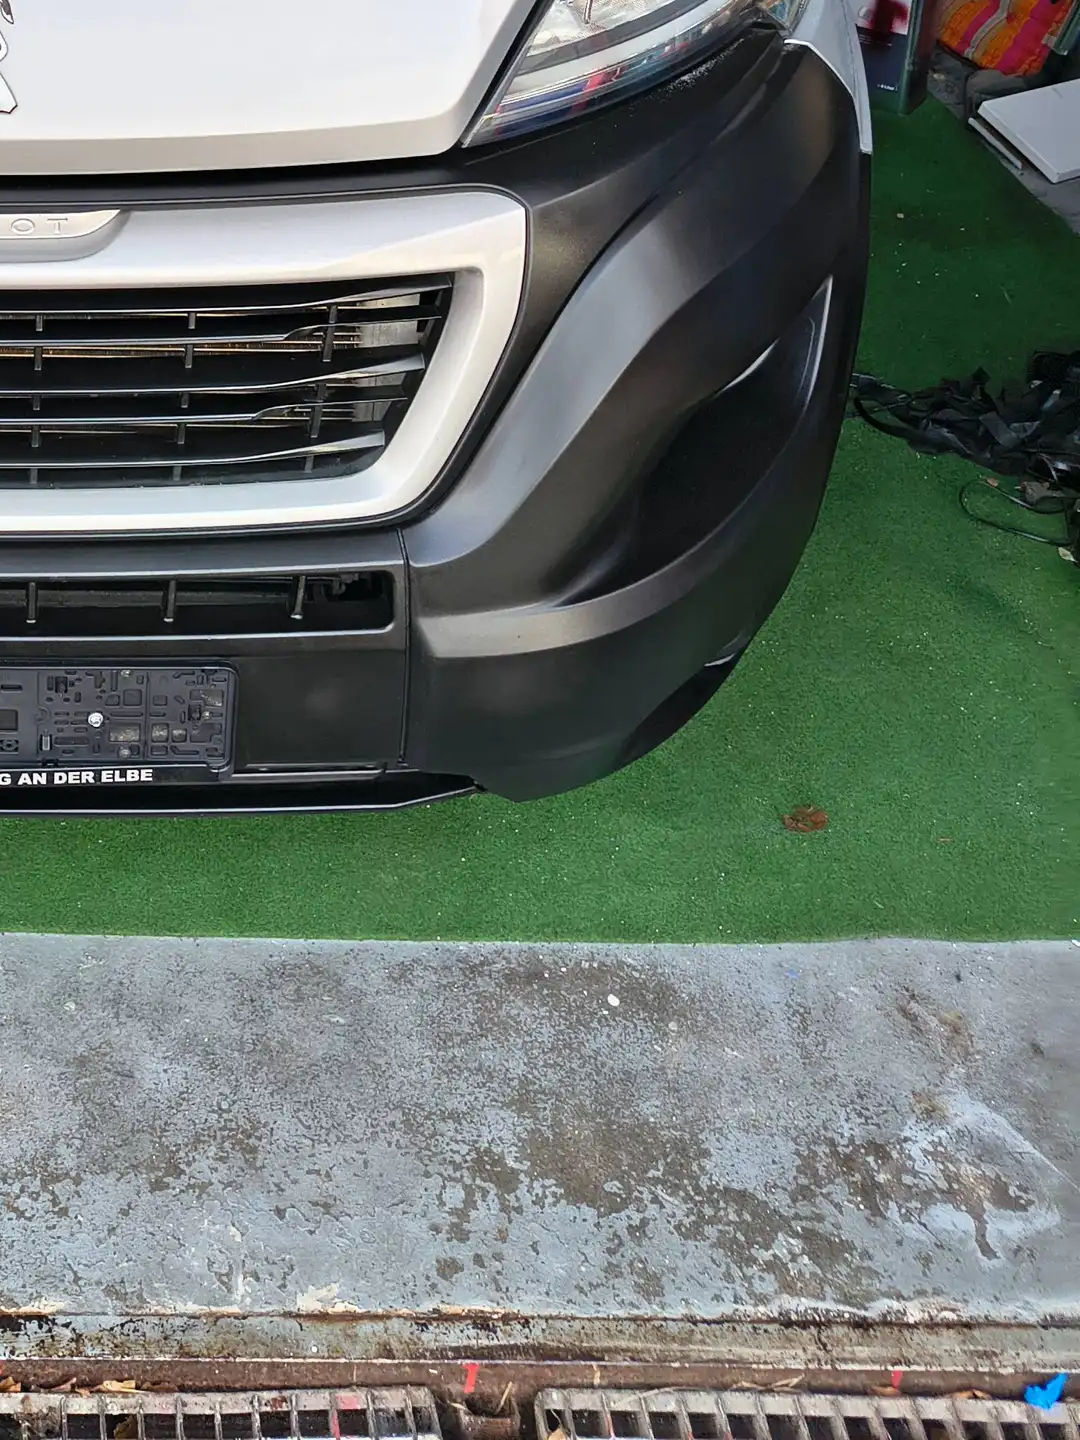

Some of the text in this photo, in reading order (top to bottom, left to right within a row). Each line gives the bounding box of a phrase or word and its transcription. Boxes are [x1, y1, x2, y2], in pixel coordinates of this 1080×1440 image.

[18, 772, 47, 786] AN
[53, 771, 95, 784] DER
[101, 769, 153, 783] ELBE
